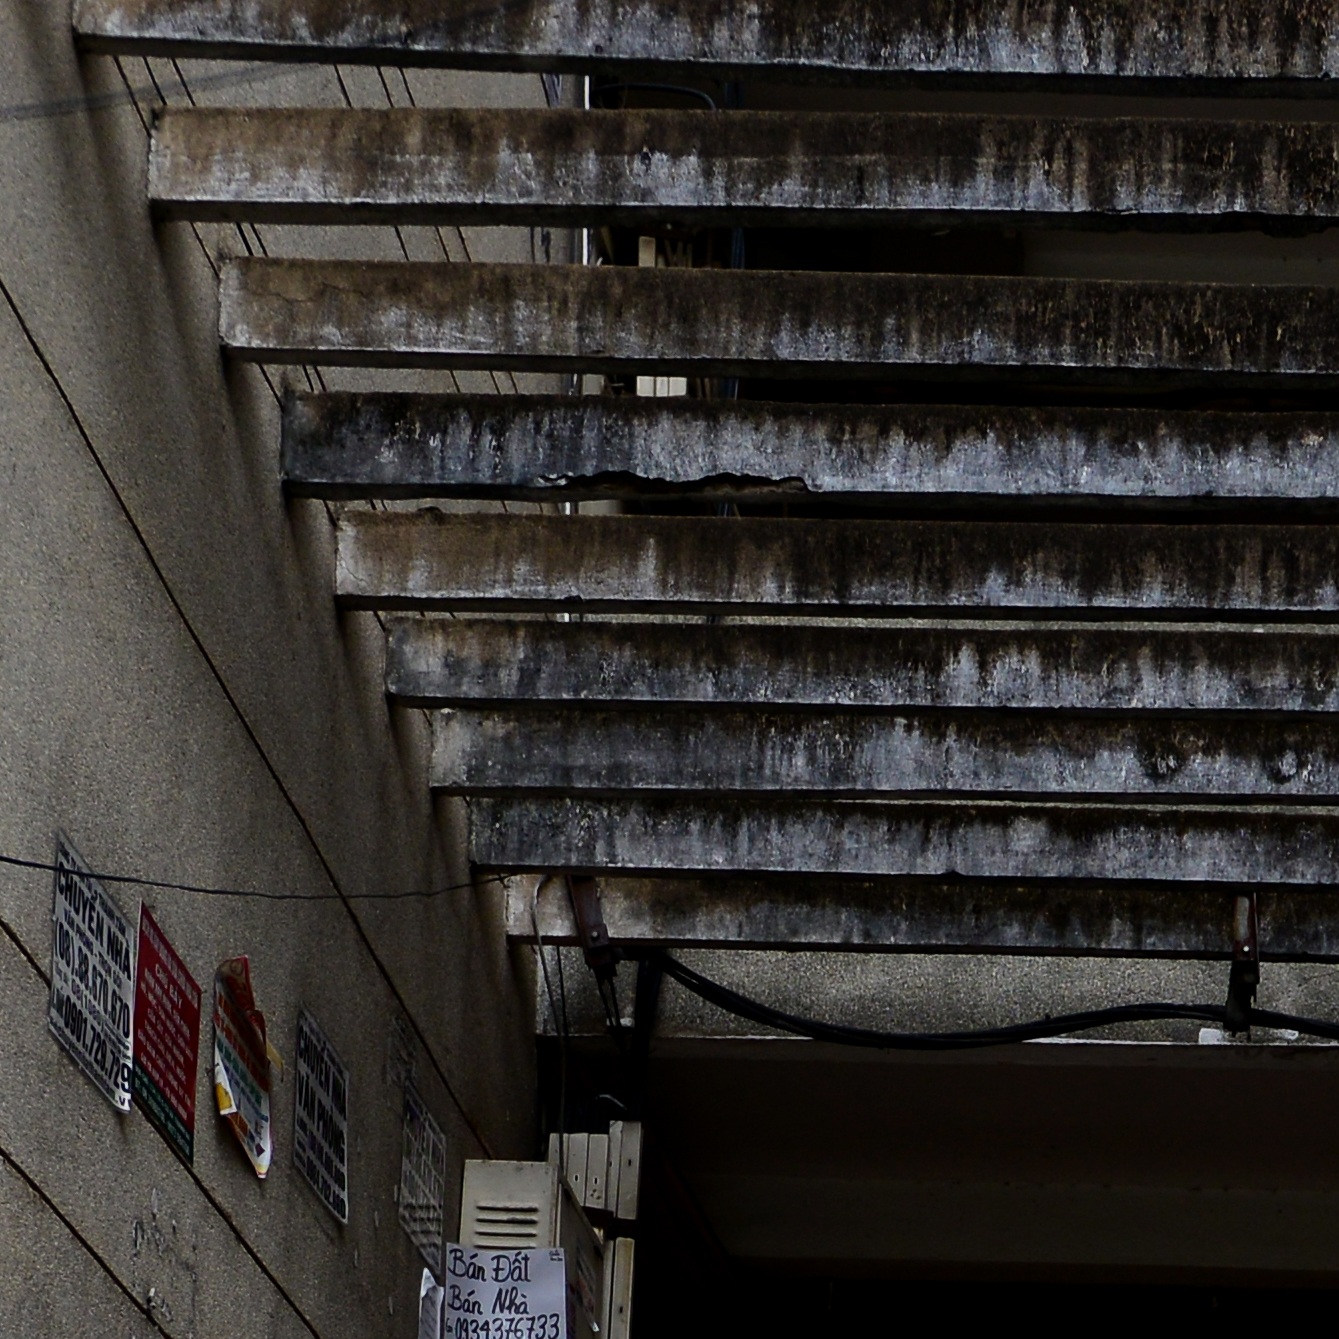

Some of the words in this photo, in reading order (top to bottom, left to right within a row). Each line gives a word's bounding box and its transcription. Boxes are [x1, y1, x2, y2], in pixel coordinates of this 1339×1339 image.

[57, 861, 103, 946] CHUYỂN
[107, 928, 131, 982] NHÀ
[448, 1248, 486, 1281] Bán
[491, 1251, 531, 1282] Đất
[448, 1285, 483, 1315] Bán
[492, 1286, 529, 1315] Nhà
